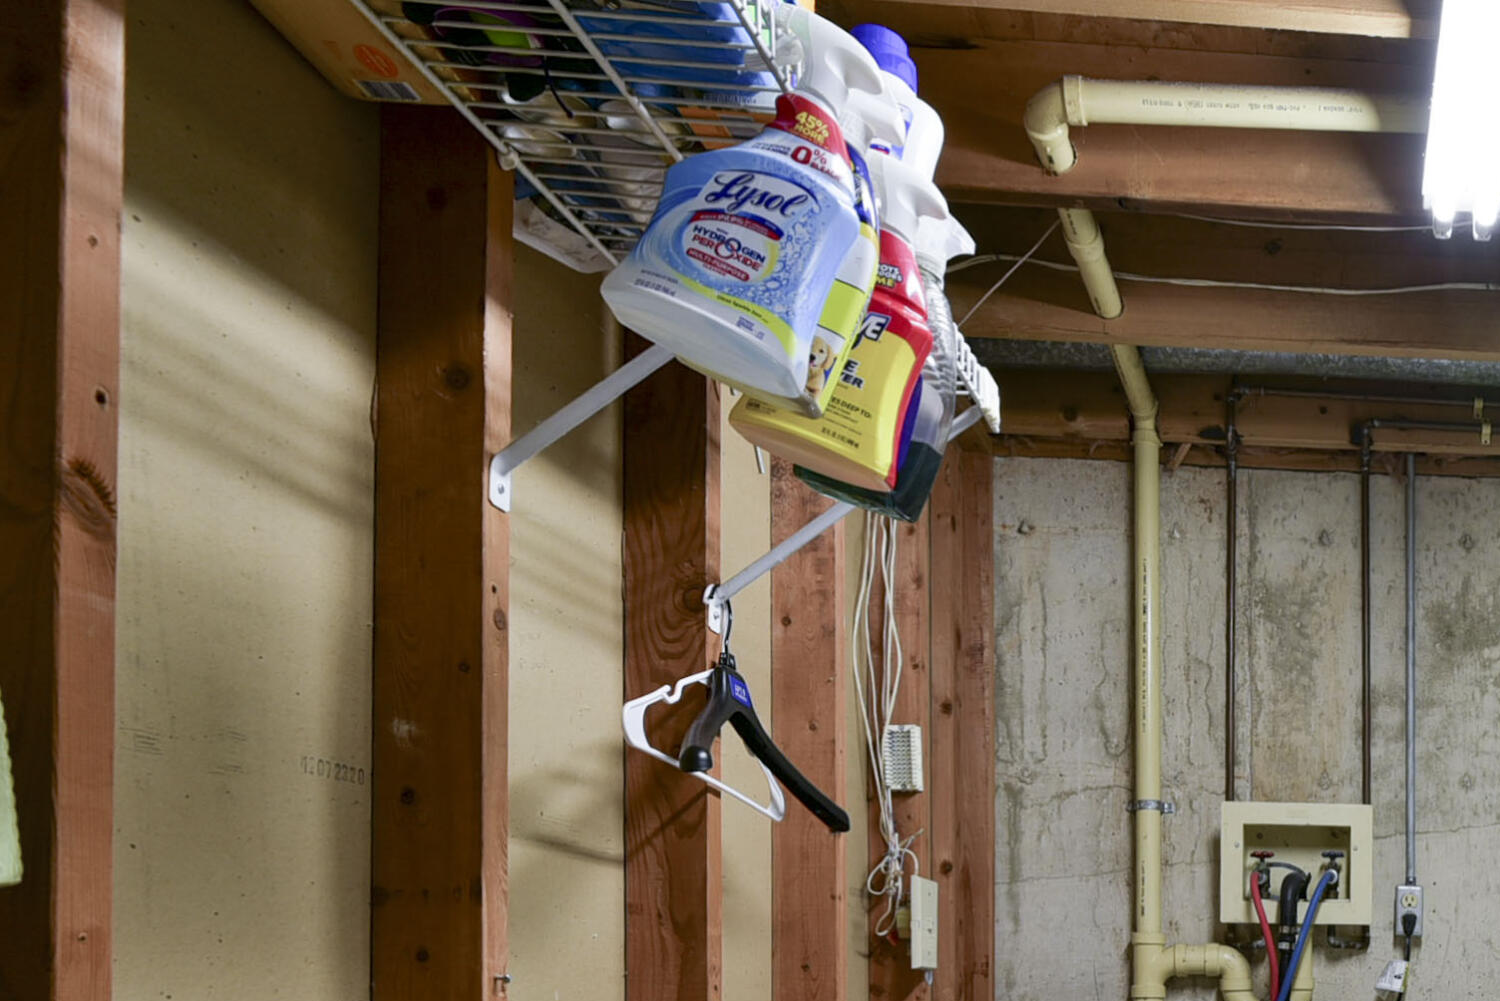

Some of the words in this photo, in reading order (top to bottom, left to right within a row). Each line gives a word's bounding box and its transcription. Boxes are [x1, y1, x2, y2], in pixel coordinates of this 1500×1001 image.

[794, 123, 825, 144] MORE
[795, 111, 829, 137] 45%
[704, 173, 809, 217] Lysol
[691, 233, 761, 271] PEROXIDE
[693, 224, 766, 263] HYDROGEN
